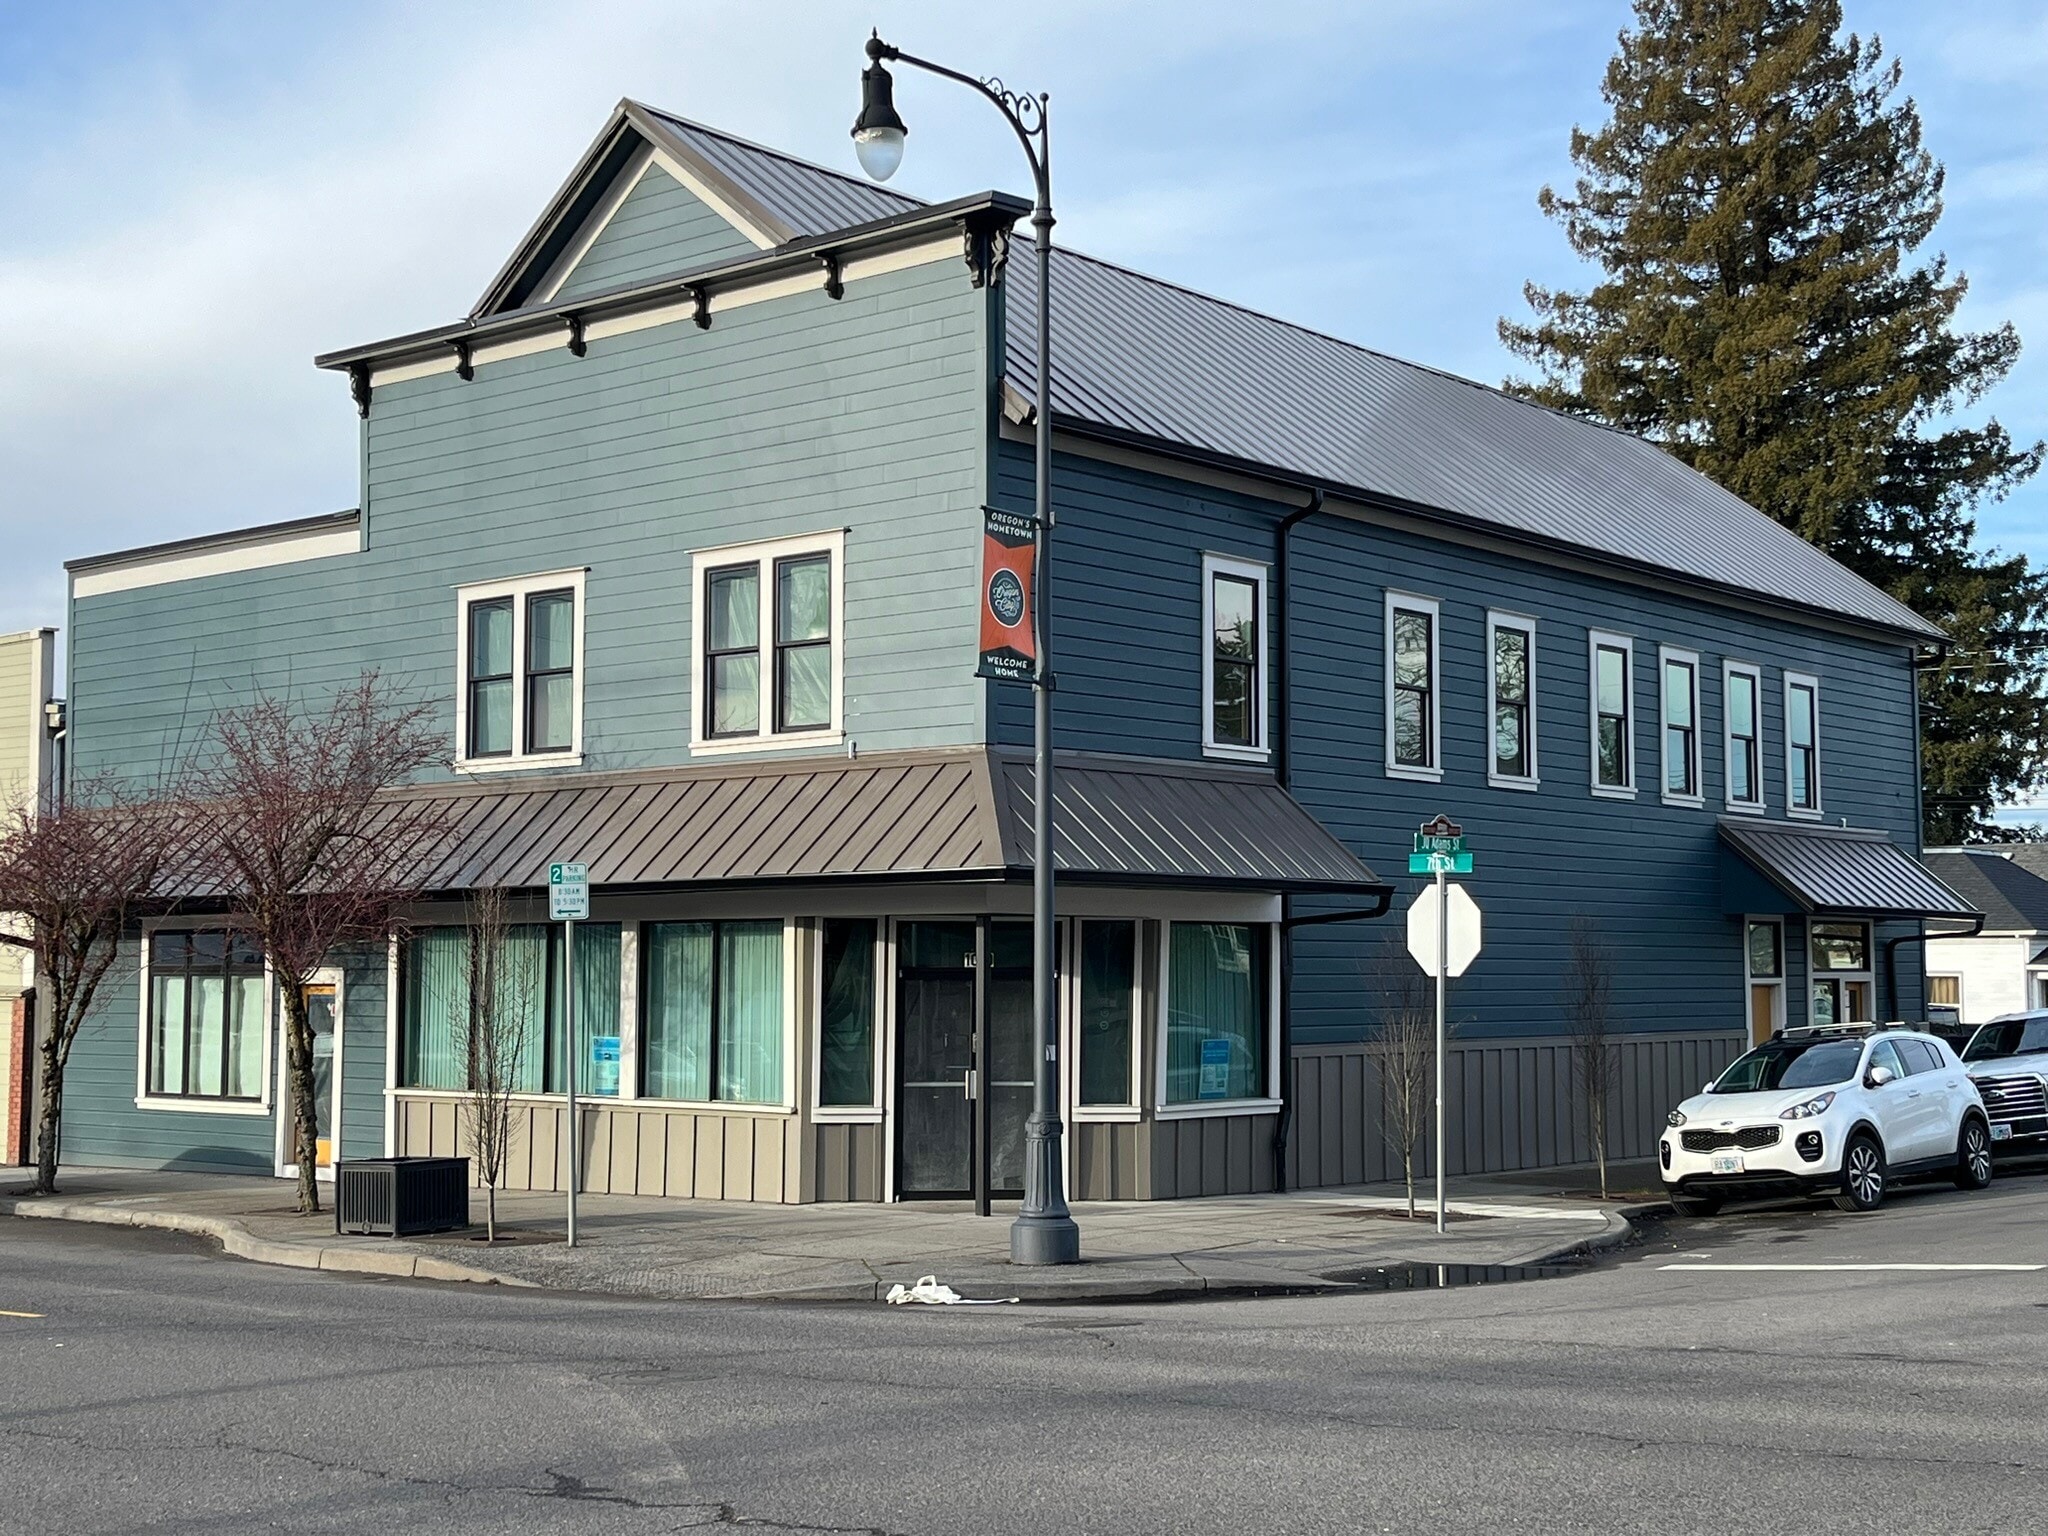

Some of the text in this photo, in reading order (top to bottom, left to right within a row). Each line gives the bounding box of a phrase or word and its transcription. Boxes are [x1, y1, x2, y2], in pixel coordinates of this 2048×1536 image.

[991, 512, 1030, 529] OREGON'S
[987, 521, 1033, 539] HOMETOWN
[987, 655, 1028, 669] WELCOME
[994, 666, 1019, 678] HOME
[1431, 837, 1451, 850] Adams
[1452, 837, 1460, 851] St
[1426, 857, 1455, 871] 7th St
[552, 868, 561, 882] 2
